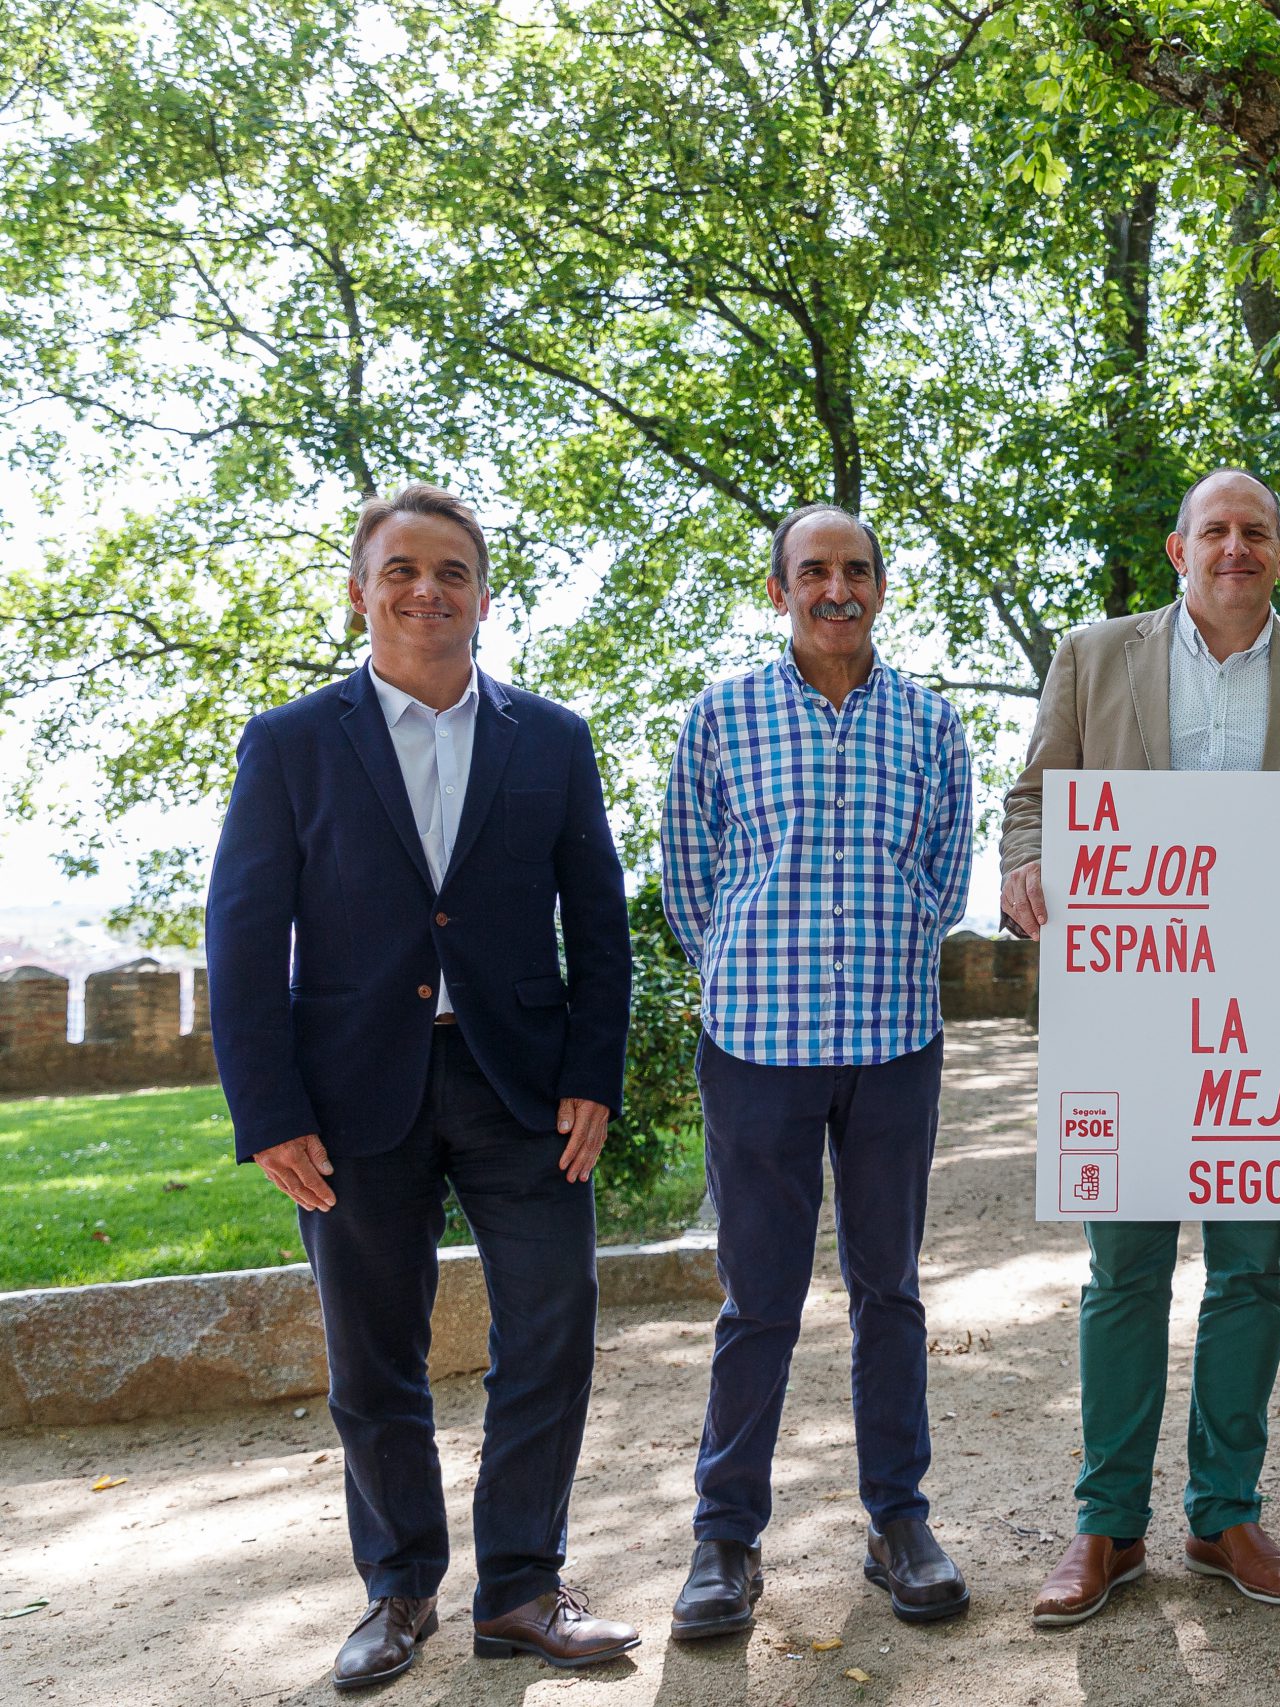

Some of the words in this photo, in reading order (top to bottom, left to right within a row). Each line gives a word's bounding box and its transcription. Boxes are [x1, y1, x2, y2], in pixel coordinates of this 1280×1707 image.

[1068, 780, 1120, 832] LA
[1069, 844, 1217, 897] MEJOR
[1066, 917, 1215, 973] ESPAÑA
[1191, 997, 1248, 1054] LA
[1065, 1119, 1114, 1137] PSOE
[1073, 1108, 1106, 1117] Segovia
